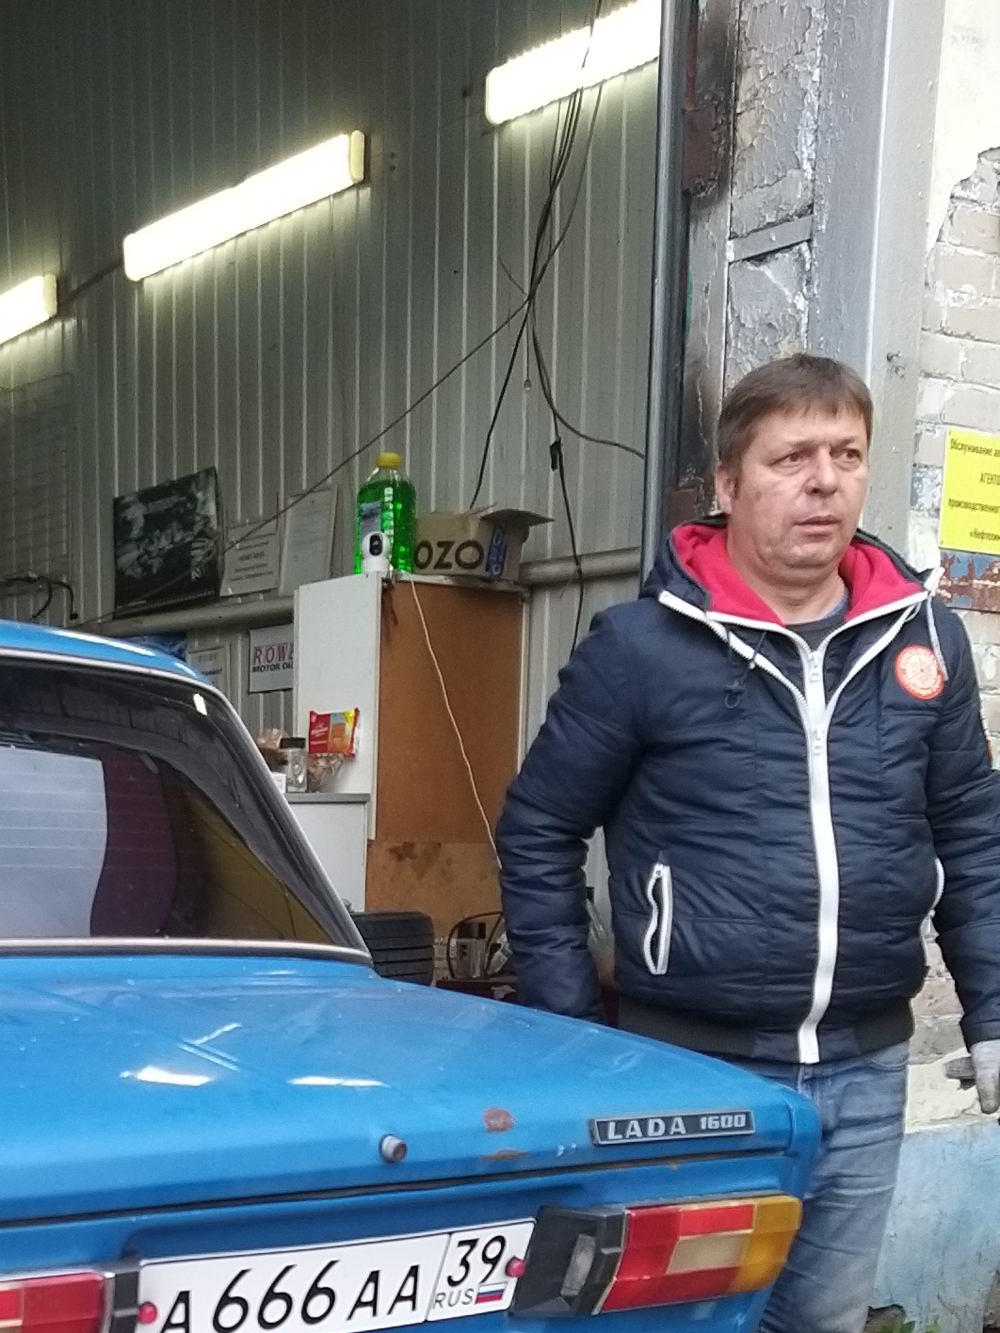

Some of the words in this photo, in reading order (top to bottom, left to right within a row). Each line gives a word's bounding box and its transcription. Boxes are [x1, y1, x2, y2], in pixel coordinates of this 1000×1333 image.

[252, 663, 280, 673] MOTOR
[607, 1116, 686, 1140] LADA
[700, 1114, 747, 1131] 1600
[447, 1235, 506, 1287] 39
[433, 1288, 476, 1309] RUS
